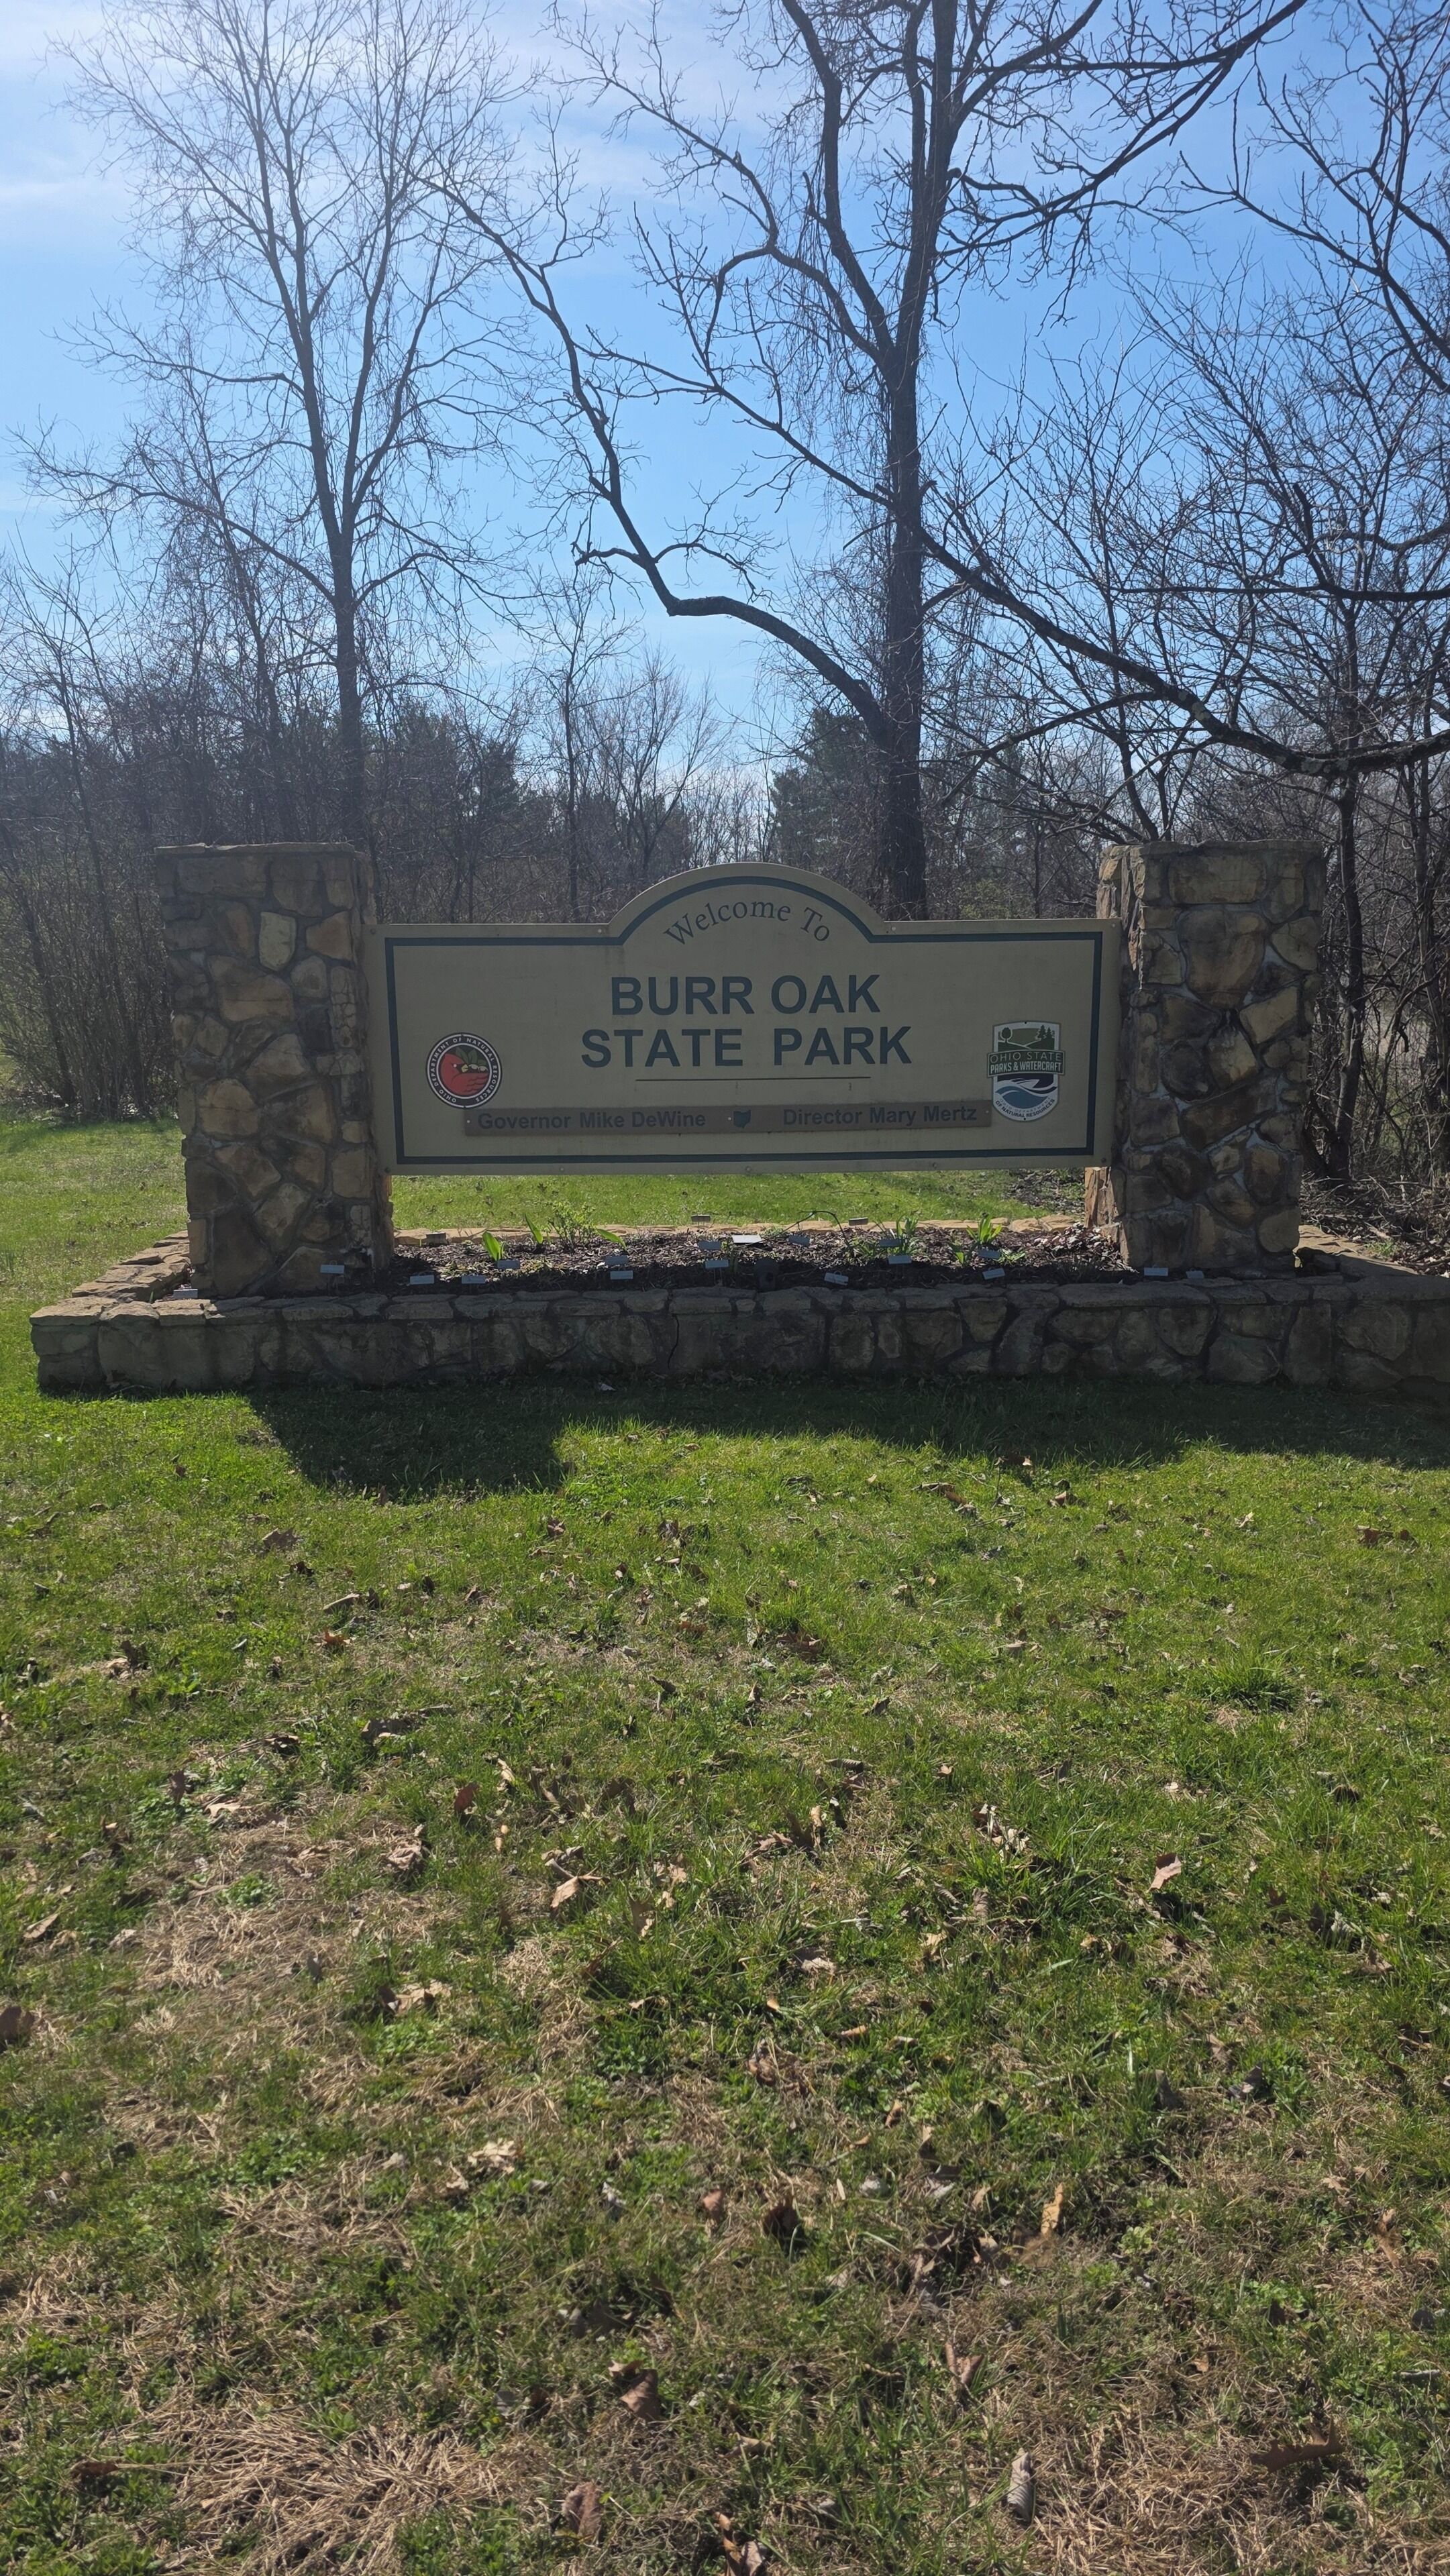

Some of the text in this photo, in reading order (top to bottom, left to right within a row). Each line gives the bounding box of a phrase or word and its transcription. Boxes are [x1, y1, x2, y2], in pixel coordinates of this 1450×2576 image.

[663, 901, 830, 945] Welcome To
[611, 974, 880, 1016] BURR OAK
[466, 1038, 495, 1061] NATURAL
[581, 1026, 912, 1068] STATE PARK
[990, 1051, 1061, 1063] OHIO STATE
[431, 1042, 449, 1086] DEPARTMENT
[990, 1061, 1061, 1074] PARKS & WATERCRAFT
[475, 1065, 497, 1102] RESOURCES
[439, 1089, 456, 1103] OHIO
[784, 1106, 977, 1126] Director Mary Mertz
[1001, 1106, 1025, 1118] NATURAL
[1026, 1098, 1055, 1117] RESOURCES
[478, 1111, 706, 1129] Governor Mike DeWine
